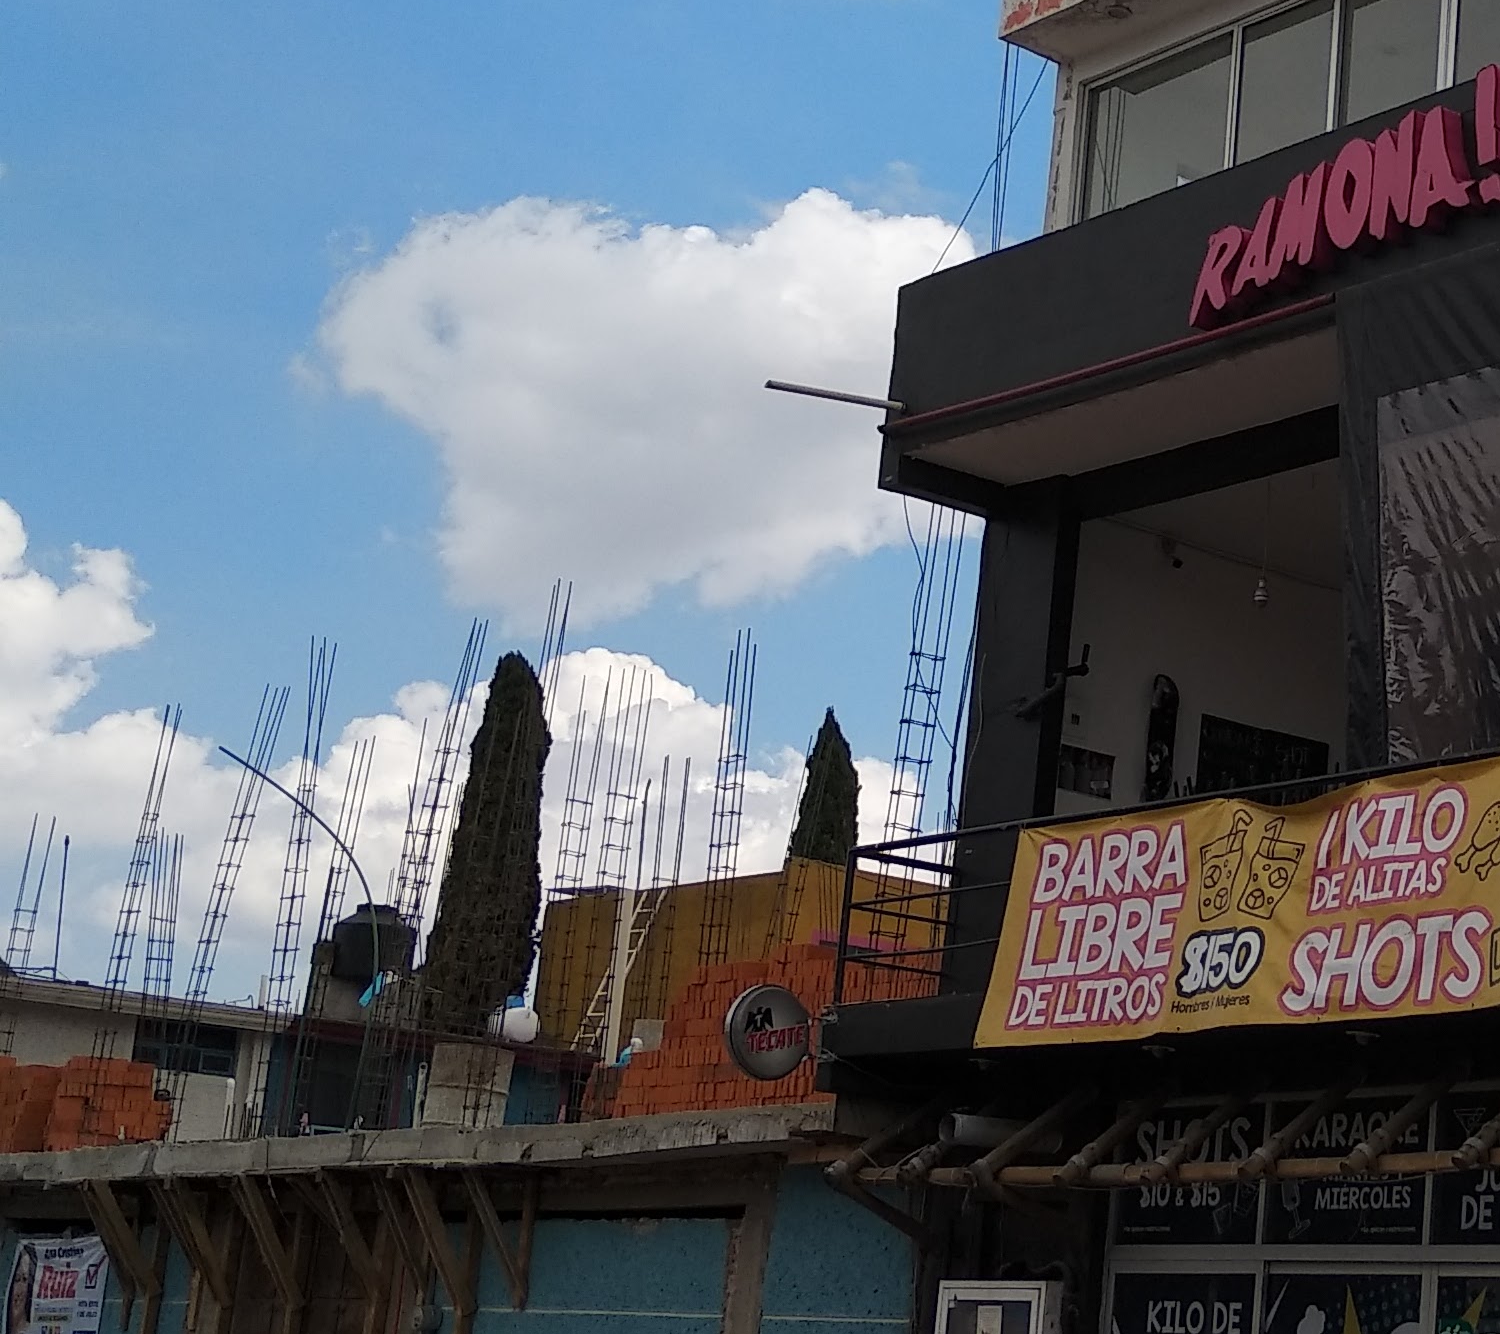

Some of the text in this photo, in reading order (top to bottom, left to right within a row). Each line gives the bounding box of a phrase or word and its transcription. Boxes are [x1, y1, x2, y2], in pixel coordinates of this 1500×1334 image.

[1341, 786, 1466, 866] KILO
[1031, 822, 1188, 905] BARRA
[1309, 858, 1448, 912] DE ALITAS
[1018, 892, 1184, 981] LIBRE
[1177, 928, 1264, 997] $150
[1281, 910, 1492, 1013] SHOTS
[1007, 972, 1167, 1027] DE LITROS
[1170, 999, 1210, 1014] Hombres
[1216, 994, 1251, 1010] Mujeres
[747, 1023, 807, 1054] TECATE
[1460, 1194, 1497, 1231] DE
[1146, 1299, 1205, 1334] KILO
